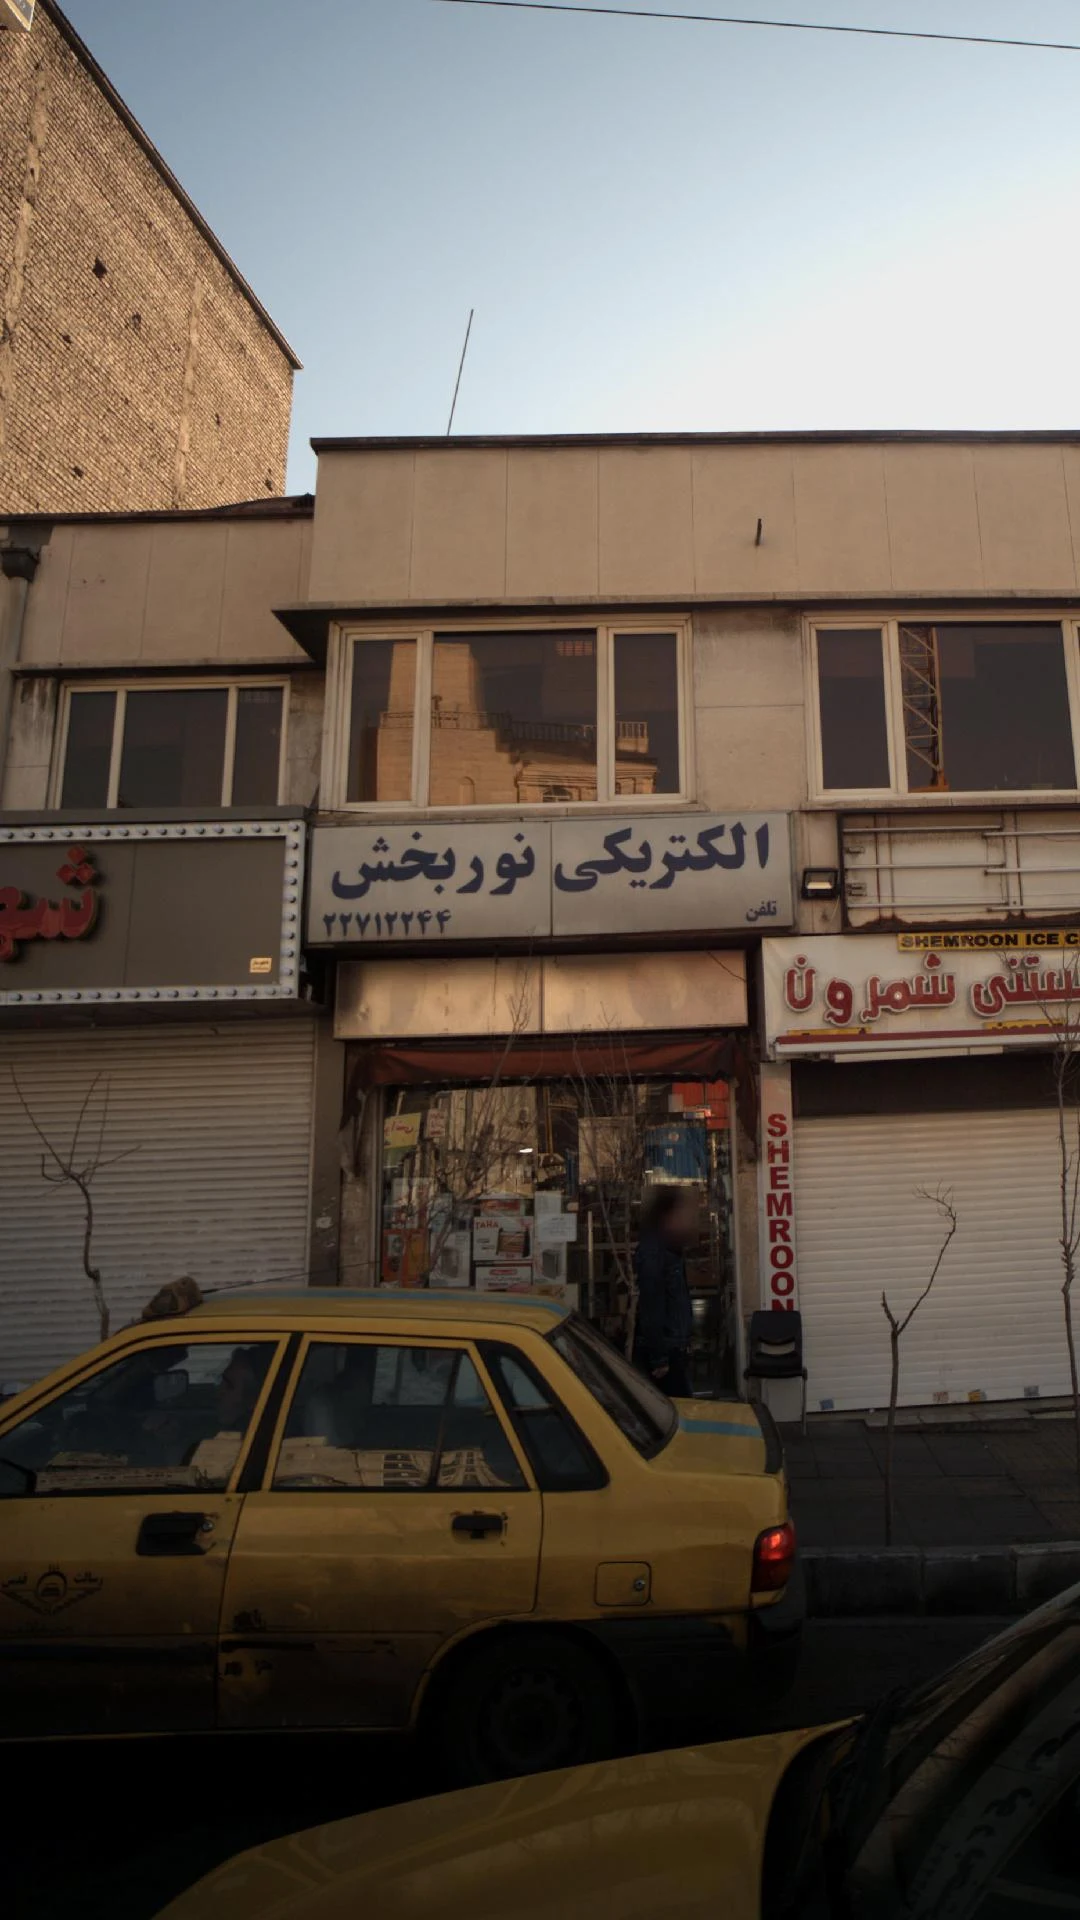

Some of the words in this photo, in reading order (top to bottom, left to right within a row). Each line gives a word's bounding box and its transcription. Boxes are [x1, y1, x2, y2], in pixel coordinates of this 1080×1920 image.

[554, 822, 769, 893] الکتریکی
[322, 908, 452, 938] ۲۲۷۱۲۲۴۴
[745, 900, 778, 923] تلفن
[901, 933, 1018, 948] SHEMROON
[1025, 933, 1060, 946] ICE
